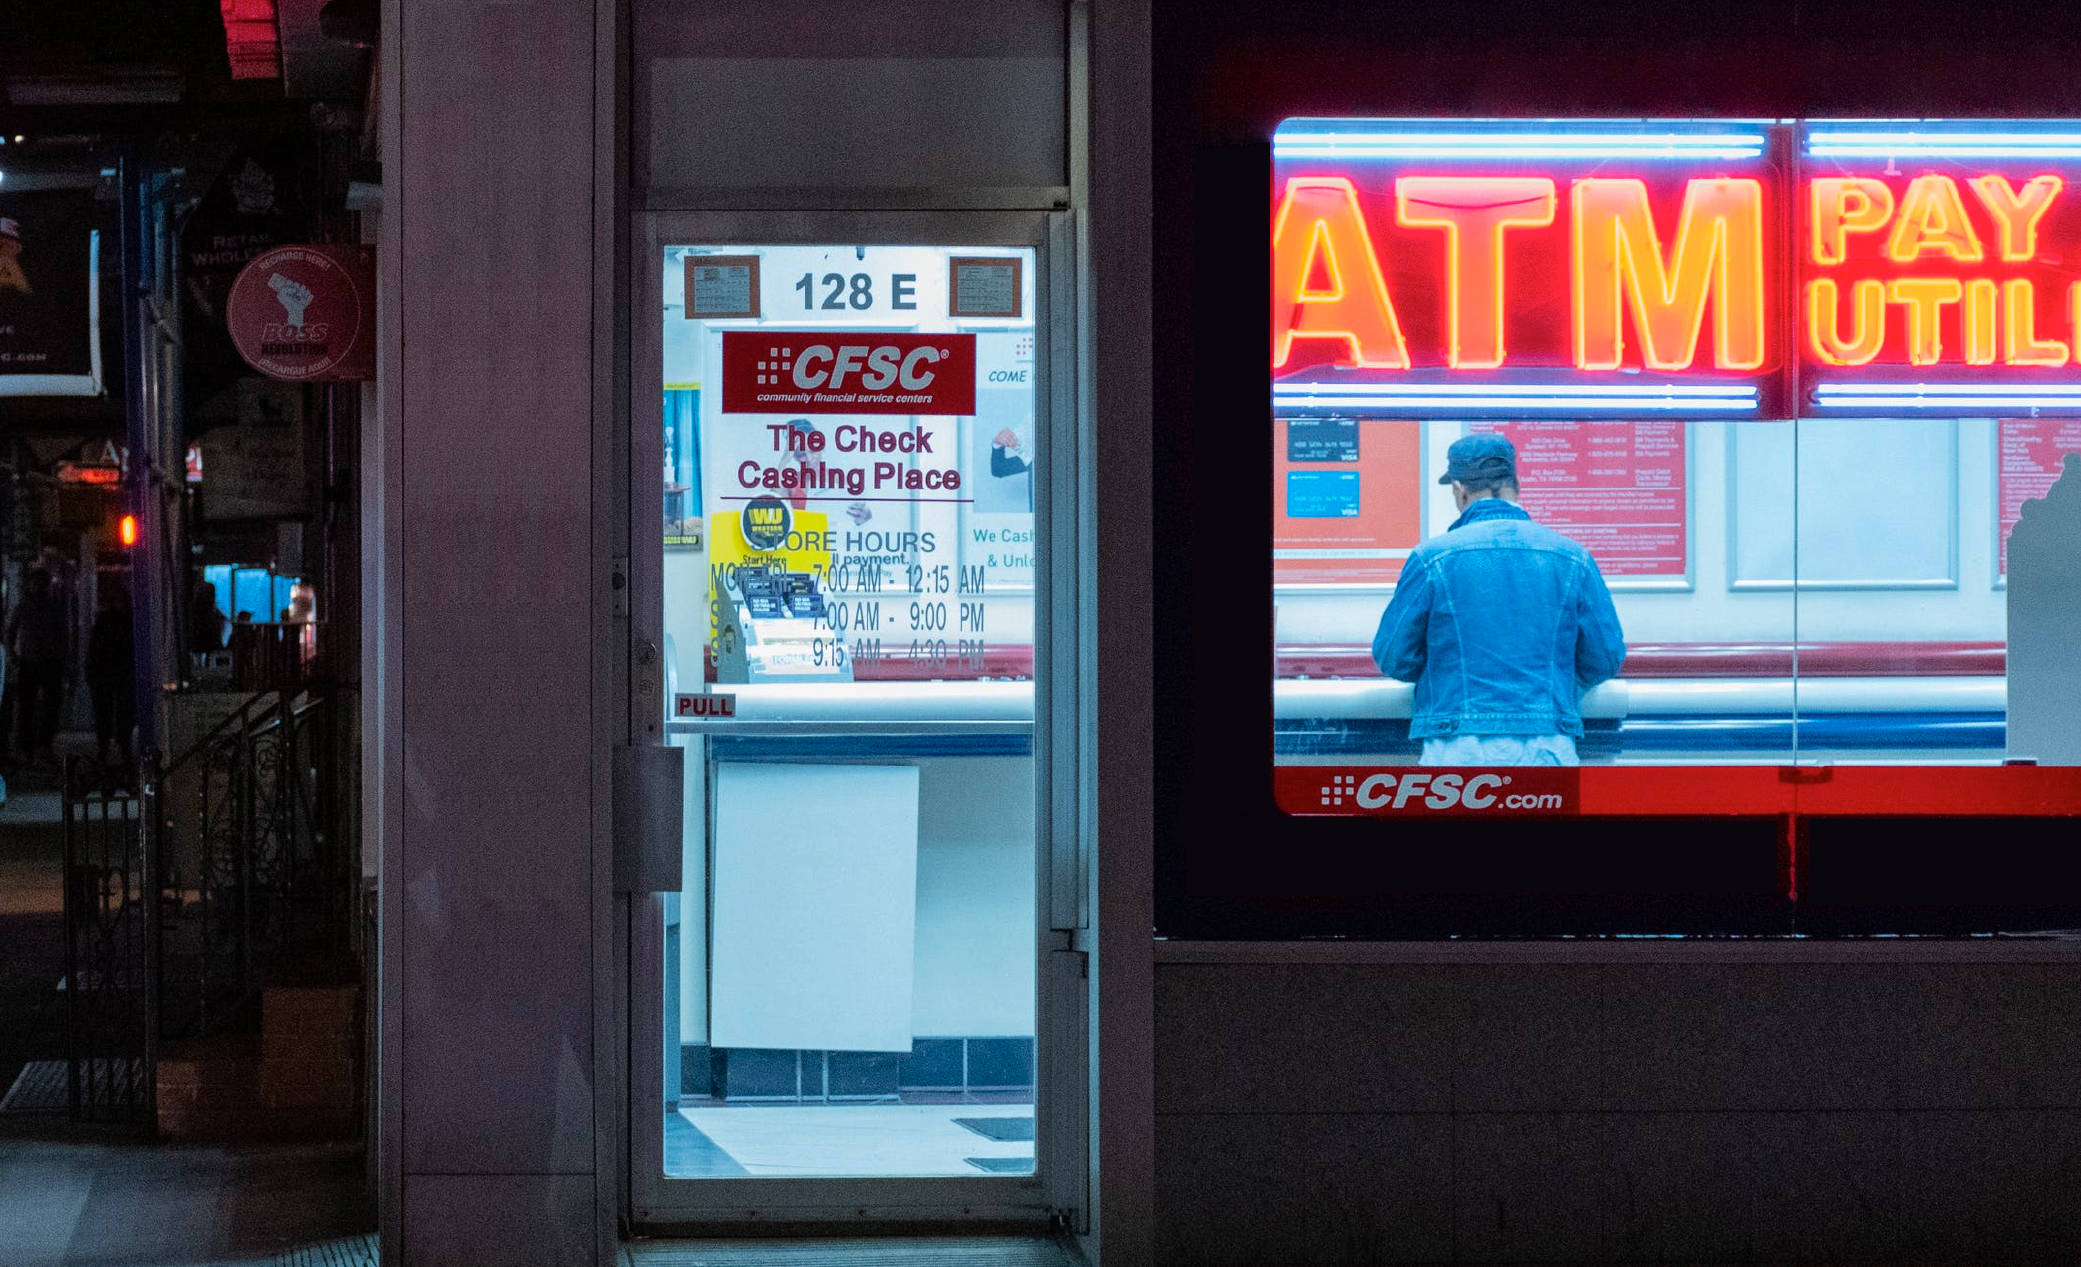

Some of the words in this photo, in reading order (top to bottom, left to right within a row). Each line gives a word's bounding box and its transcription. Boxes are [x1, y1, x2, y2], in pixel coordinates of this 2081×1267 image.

[1809, 174, 2064, 264] PAY
[1274, 176, 1767, 370] ATM
[796, 272, 874, 311] 128
[891, 273, 917, 310] E
[260, 322, 329, 343] BOSS
[1806, 279, 2081, 366] UTIL
[792, 344, 941, 391] CFSC
[989, 370, 1027, 382] COME
[757, 392, 811, 404] community
[814, 392, 855, 403] financial
[857, 394, 893, 403] service
[896, 394, 933, 403] centers
[766, 424, 826, 452] The
[834, 424, 934, 454] Check
[737, 460, 865, 496] Cashing
[873, 462, 961, 490] Place
[750, 531, 838, 552] STORE
[846, 531, 936, 553] HOURS
[973, 528, 996, 542] We
[742, 554, 764, 565] Start
[766, 554, 787, 565] Here
[843, 553, 909, 568] payment.
[988, 554, 997, 567] &
[813, 564, 849, 593] 7:00
[856, 564, 881, 593] AM
[905, 564, 949, 594] 12:15
[959, 565, 985, 594] AM
[853, 601, 880, 631] AM
[910, 602, 947, 631] 9:00
[960, 603, 985, 632] PM
[813, 637, 844, 667] 9:15
[854, 638, 880, 668] AM
[908, 639, 947, 669] 4:30
[959, 639, 985, 670] PM
[679, 697, 733, 716] PULL
[1356, 773, 1563, 810] CFSC.com
